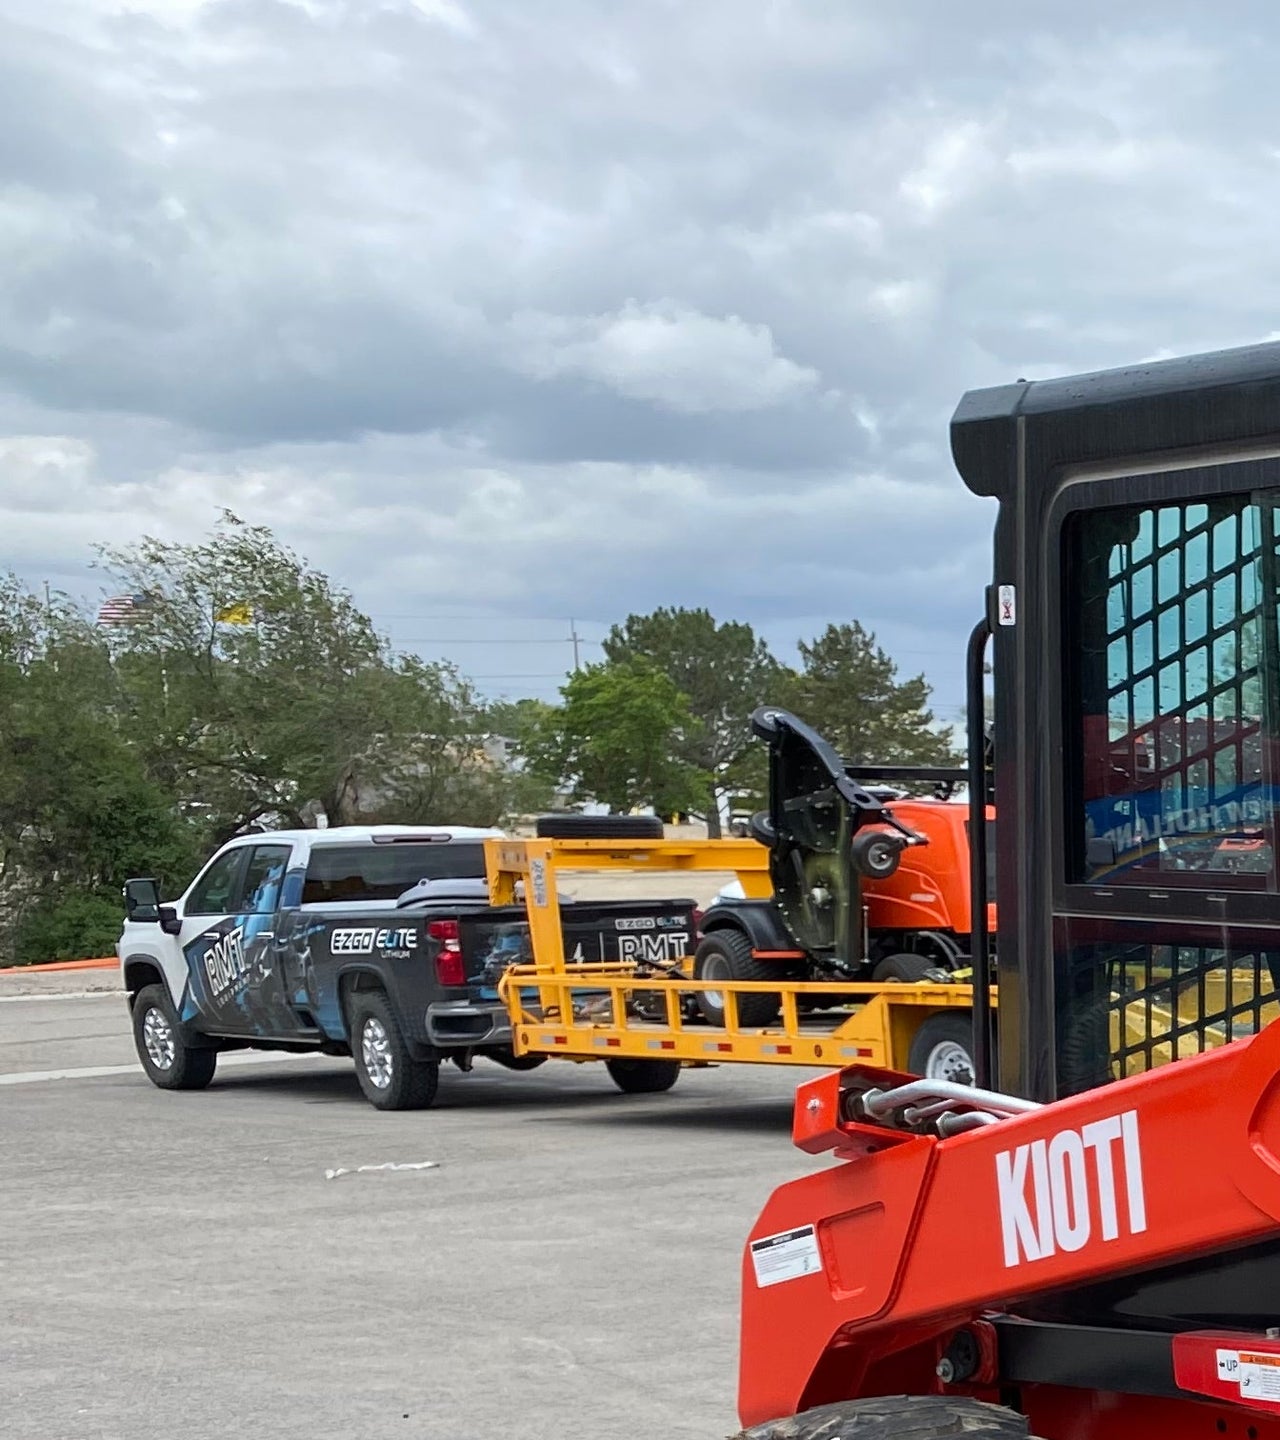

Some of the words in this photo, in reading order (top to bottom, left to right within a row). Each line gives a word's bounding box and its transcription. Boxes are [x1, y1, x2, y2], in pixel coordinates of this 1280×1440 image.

[332, 930, 374, 952] EZGO
[618, 932, 689, 963] RMT
[204, 925, 246, 996] RMT
[995, 1110, 1147, 1268] KIOTI
[1226, 1360, 1238, 1371] UP
